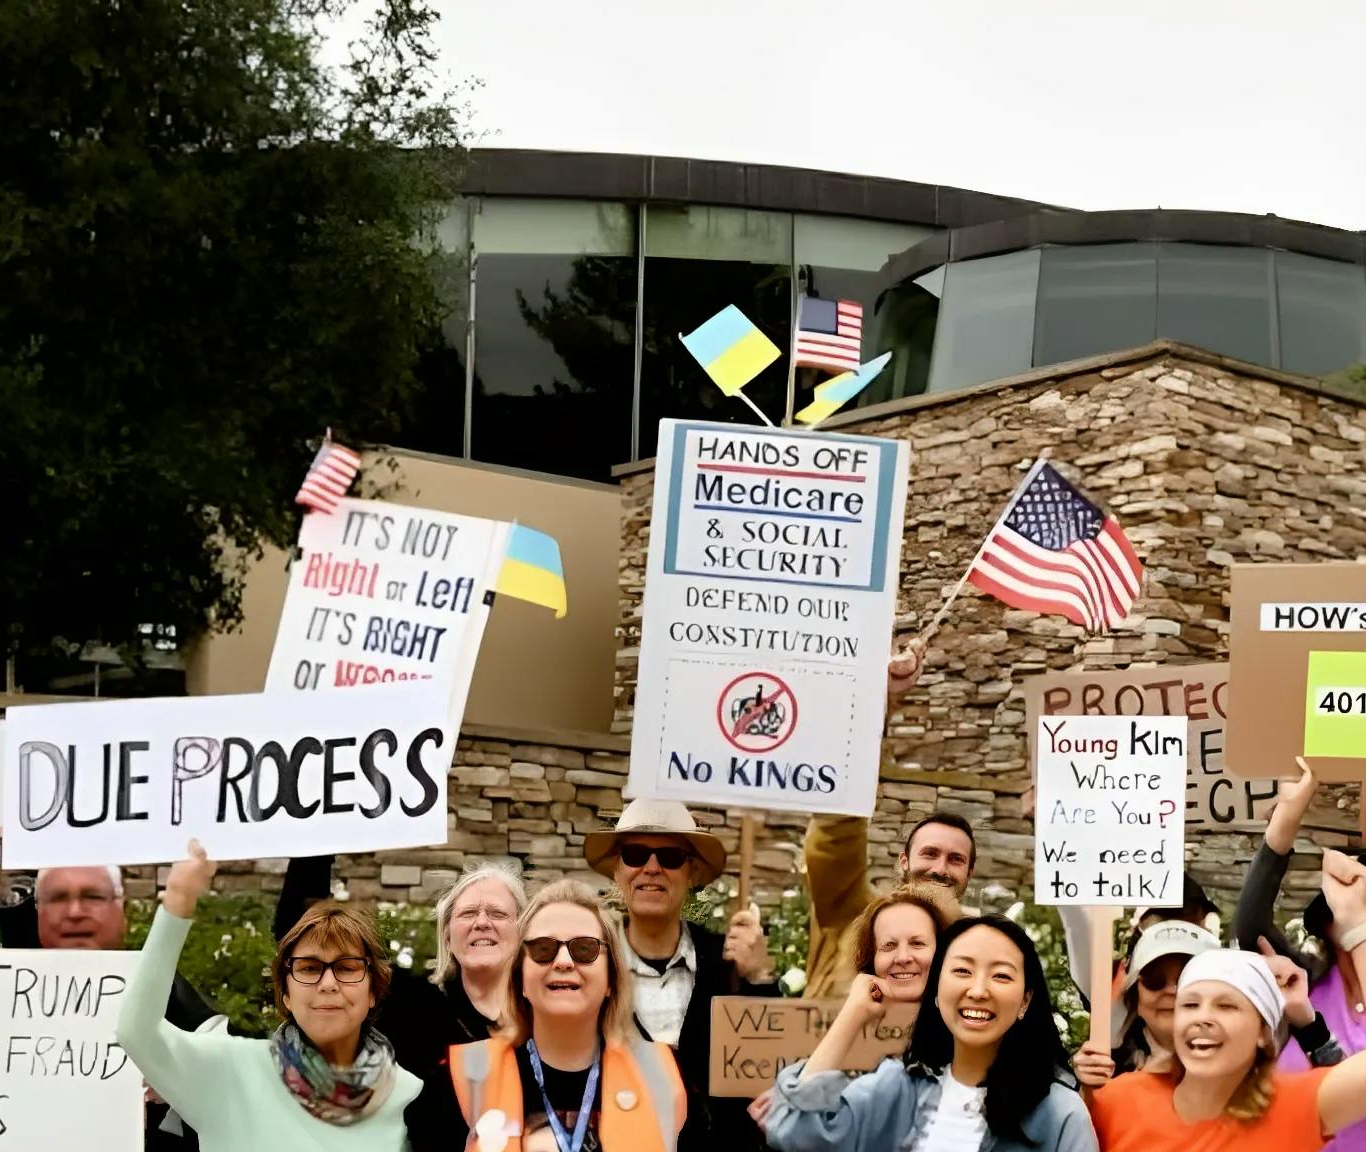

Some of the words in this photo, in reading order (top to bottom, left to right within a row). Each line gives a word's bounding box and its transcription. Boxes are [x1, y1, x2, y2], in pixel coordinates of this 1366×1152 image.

[698, 436, 801, 468] HANDS
[813, 447, 868, 473] OFF
[694, 473, 865, 516] Medicare
[342, 510, 395, 551] IT'S
[401, 518, 459, 561] NOT
[706, 519, 724, 541] &
[742, 521, 848, 549] SOCIAL
[703, 545, 848, 578] SECURITY
[303, 552, 380, 598] Right
[385, 581, 408, 602] or
[415, 571, 475, 614] Left
[686, 586, 788, 616] DEFEND
[798, 598, 850, 622] OUR
[306, 606, 356, 646] IT'S
[362, 615, 447, 663] RIGHT
[669, 621, 859, 658] CONSTITUTION
[293, 659, 326, 690] or
[1042, 720, 1118, 760] Young
[18, 740, 150, 832] DUE
[171, 727, 444, 826] PROCESS
[667, 752, 713, 783] No
[728, 757, 837, 794] KINGS
[1069, 760, 1161, 790] Where
[1050, 800, 1097, 825] Are
[1111, 800, 1176, 829] You?
[1042, 840, 1077, 863] We
[1099, 839, 1167, 864] need
[1050, 870, 1079, 899] to
[722, 1003, 785, 1034] WE
[6, 1036, 128, 1080] FRAUD
